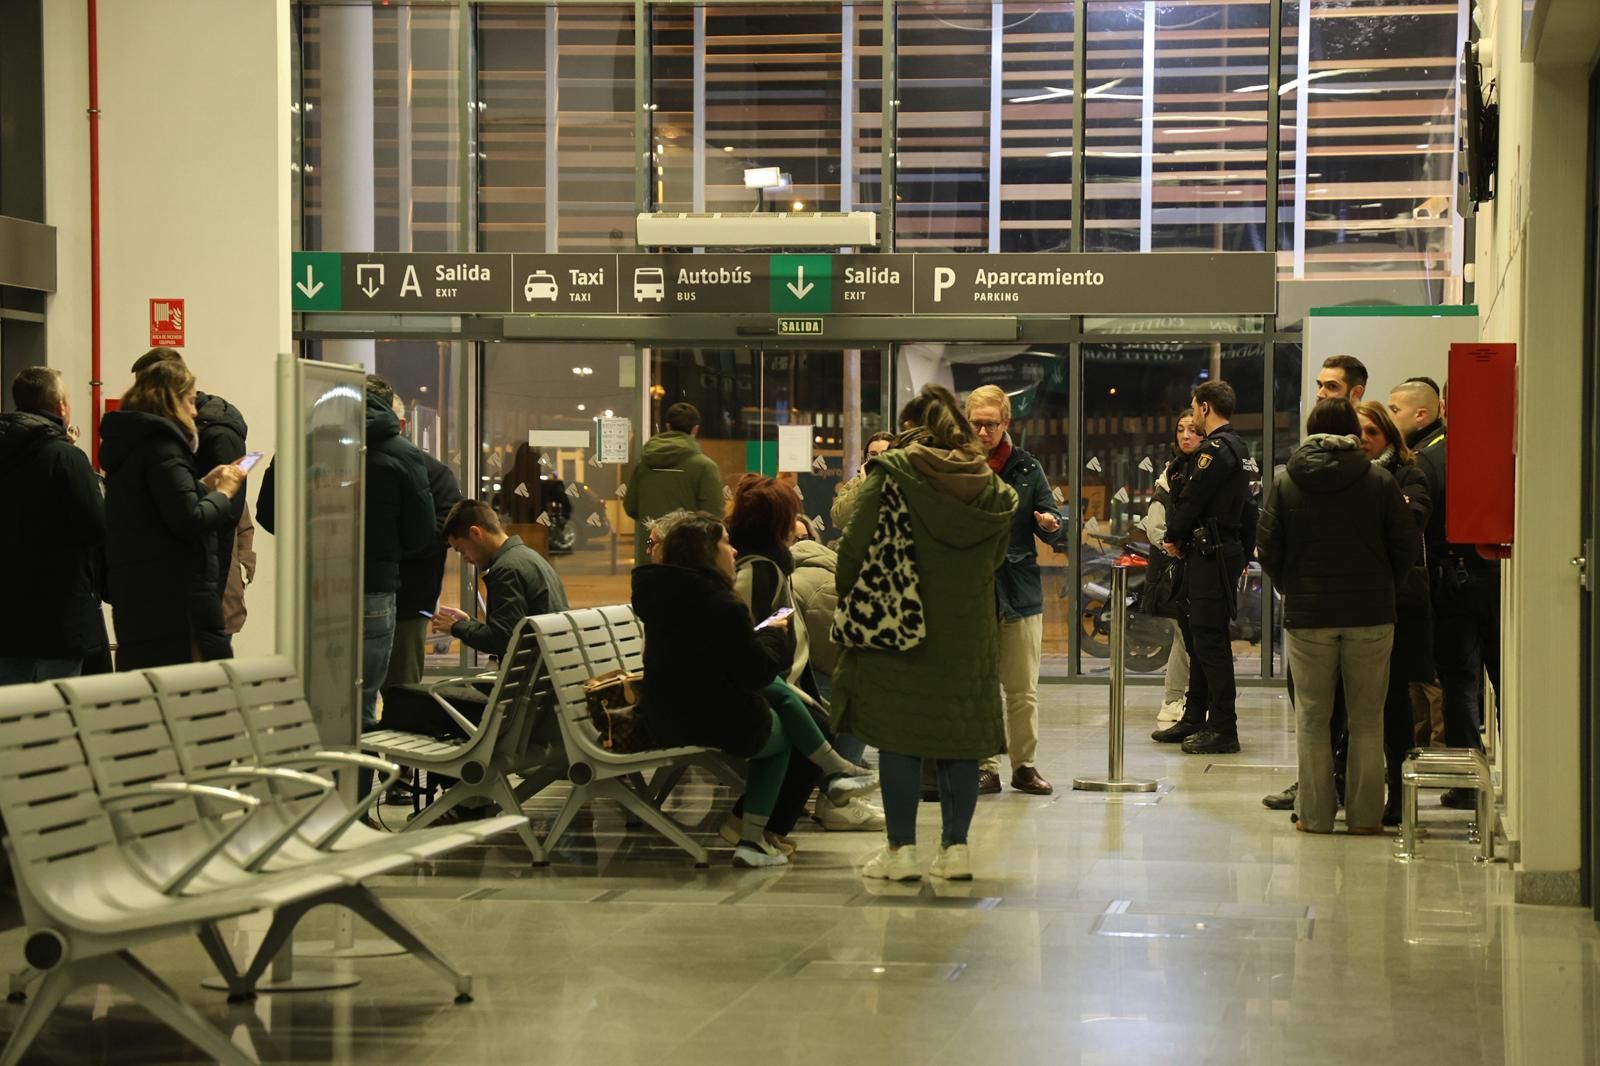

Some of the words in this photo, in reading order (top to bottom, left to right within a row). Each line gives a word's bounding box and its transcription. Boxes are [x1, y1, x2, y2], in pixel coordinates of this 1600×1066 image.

[435, 264, 491, 281] Salida
[568, 267, 604, 286] Taxi
[677, 266, 752, 284] Autobús
[844, 266, 900, 285] Salida
[974, 267, 1105, 289] Aparcamiento
[399, 265, 423, 298] A
[933, 266, 957, 303] P
[435, 288, 458, 298] EXIT
[568, 292, 592, 302] TAXI
[677, 292, 696, 301] BUS
[844, 291, 867, 301] EXIT
[974, 292, 1019, 302] PARKING
[782, 321, 819, 332] SALIDA
